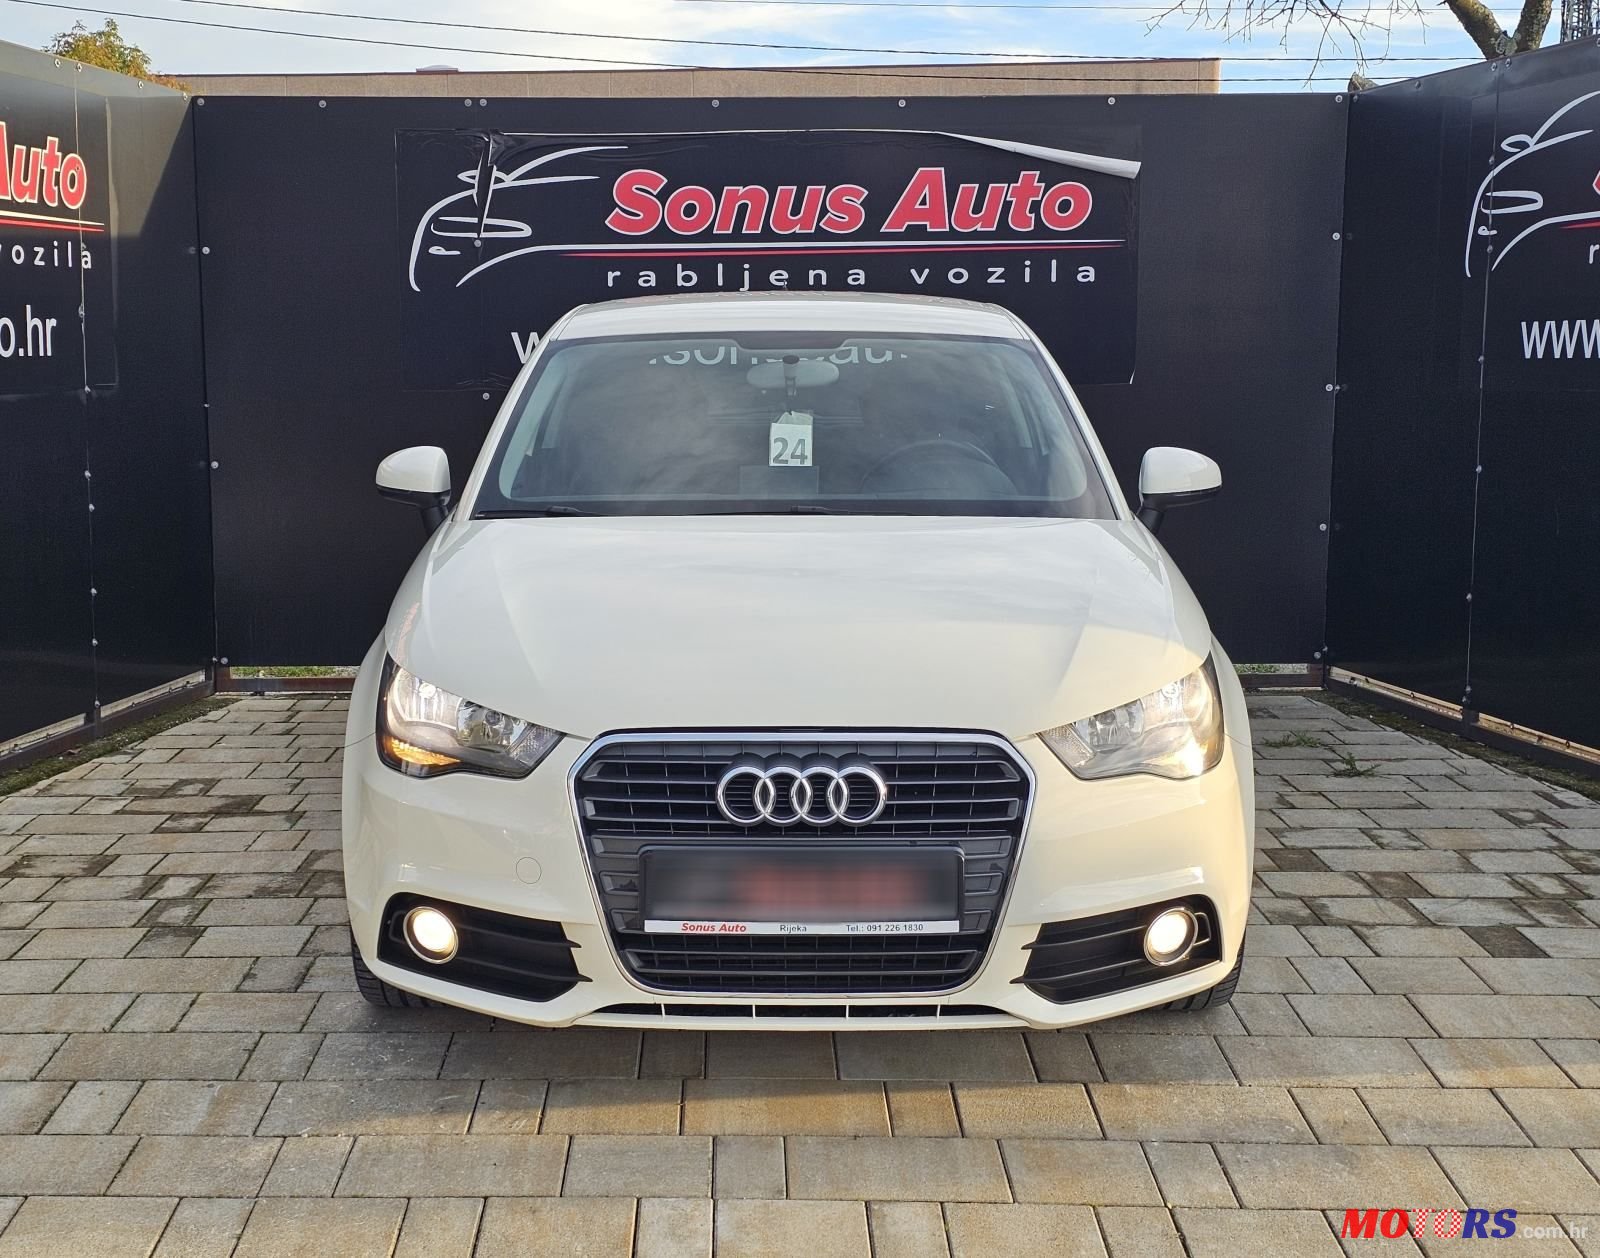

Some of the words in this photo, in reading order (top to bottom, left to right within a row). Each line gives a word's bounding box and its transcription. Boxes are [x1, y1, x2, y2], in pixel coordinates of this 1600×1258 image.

[605, 169, 868, 235] Sonus
[880, 167, 1093, 232] Auto
[0, 240, 92, 269] ozila
[607, 263, 866, 291] rabljena
[910, 259, 1096, 284] vozila
[772, 437, 808, 465] 24
[681, 922, 716, 932] Sonus
[718, 923, 747, 933] Auto
[780, 924, 807, 934] Rijeka
[867, 924, 882, 932] 091
[885, 924, 900, 932] 226
[904, 923, 924, 932] 1830
